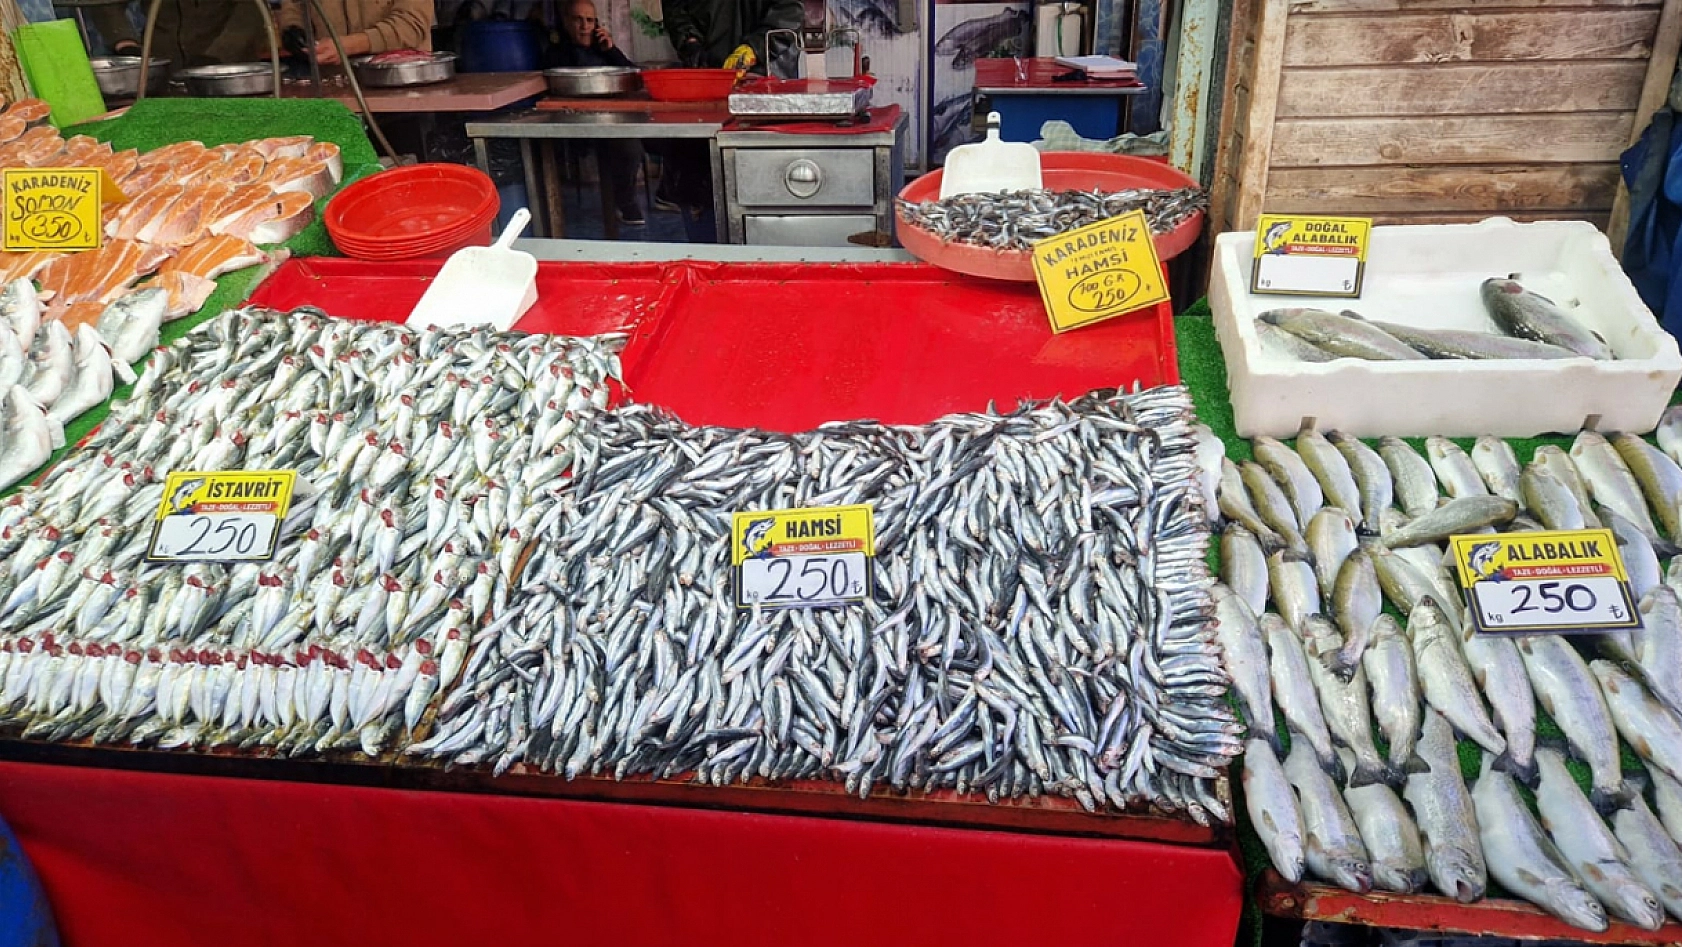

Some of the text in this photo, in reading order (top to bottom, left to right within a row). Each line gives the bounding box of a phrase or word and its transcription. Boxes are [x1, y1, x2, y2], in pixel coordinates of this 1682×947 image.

[11, 175, 92, 194] KARADENİZ
[12, 195, 85, 221] SOMON
[31, 214, 71, 238] 350
[1305, 222, 1348, 233] DOĞAL
[1043, 225, 1138, 267] KARADENİZ
[1293, 233, 1358, 244] ALABALIK
[1066, 248, 1128, 279] HAMSİ
[1092, 288, 1125, 309] 250
[206, 477, 282, 498] İSTAVRİT
[176, 516, 257, 555] 250
[786, 514, 842, 538] HAMSİ
[1507, 540, 1603, 562] ALABALIK
[765, 558, 849, 600] 250
[1510, 582, 1597, 614] 250
